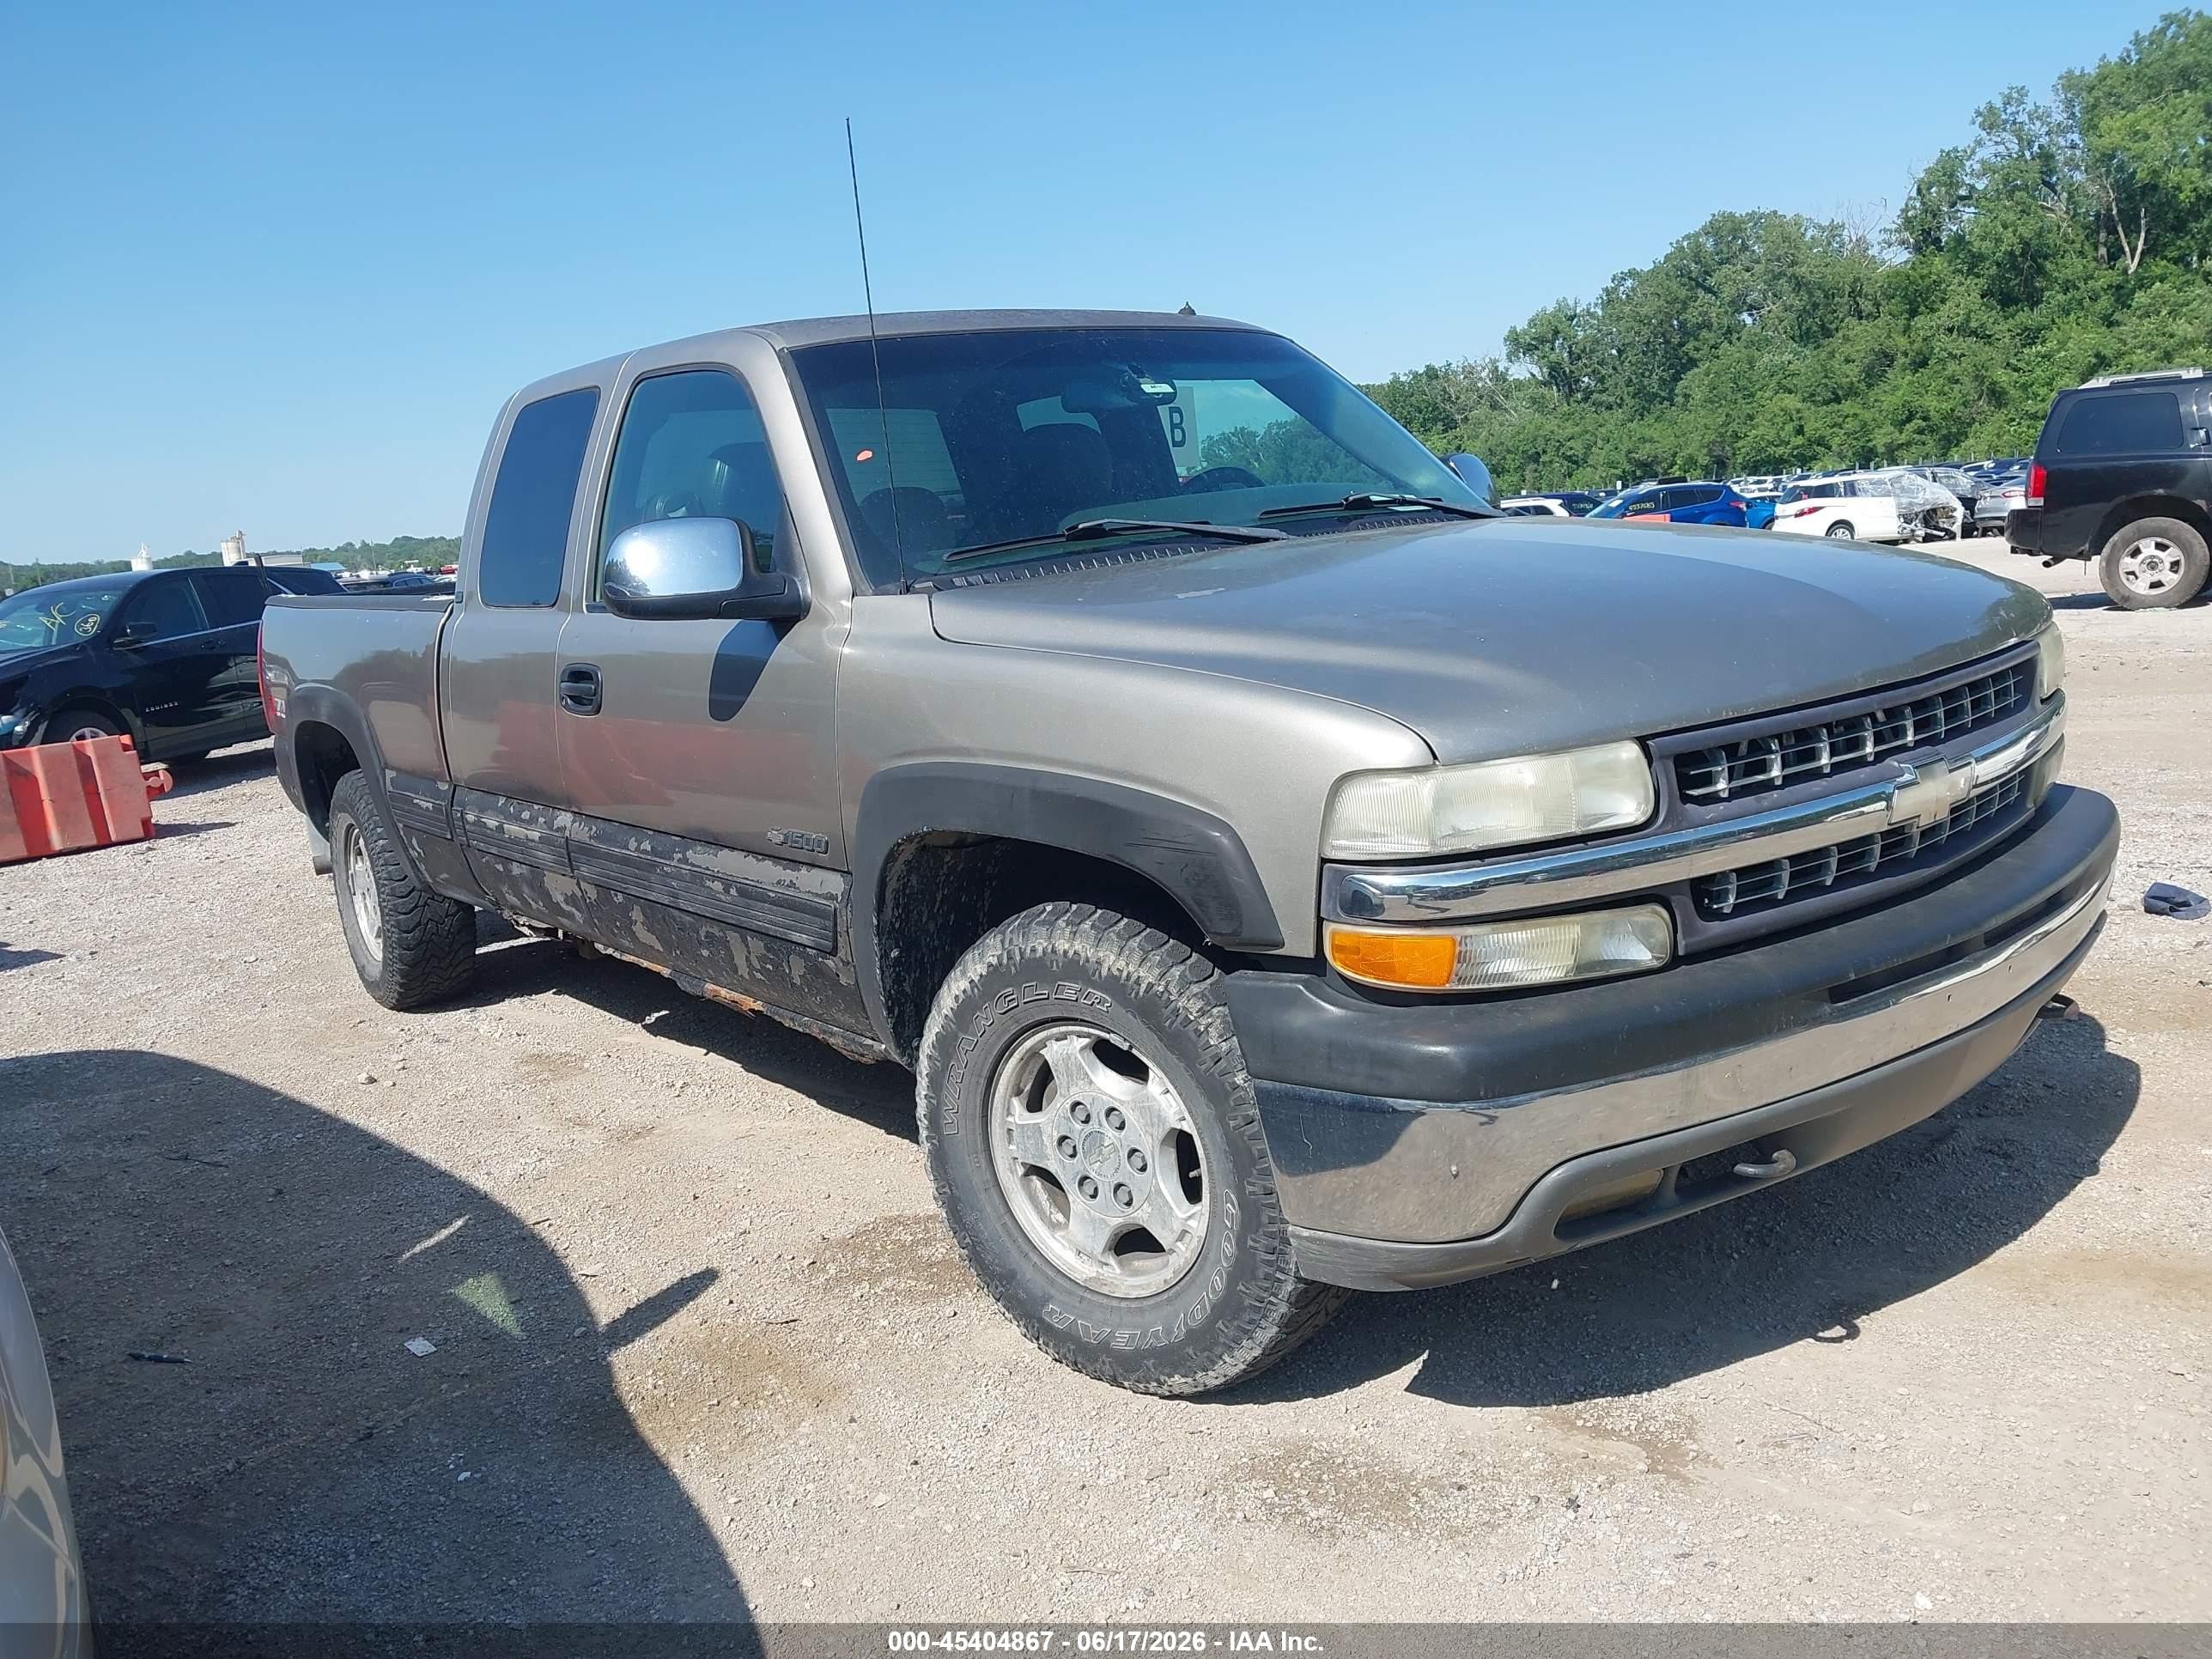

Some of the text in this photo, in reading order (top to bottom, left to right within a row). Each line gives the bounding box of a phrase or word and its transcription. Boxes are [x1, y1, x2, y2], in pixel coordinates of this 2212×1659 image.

[1169, 406, 1186, 447] B
[782, 829, 829, 855] 1500
[943, 981, 1113, 1136] WRANGLER
[1042, 1188, 1239, 1351] GOODYEAR
